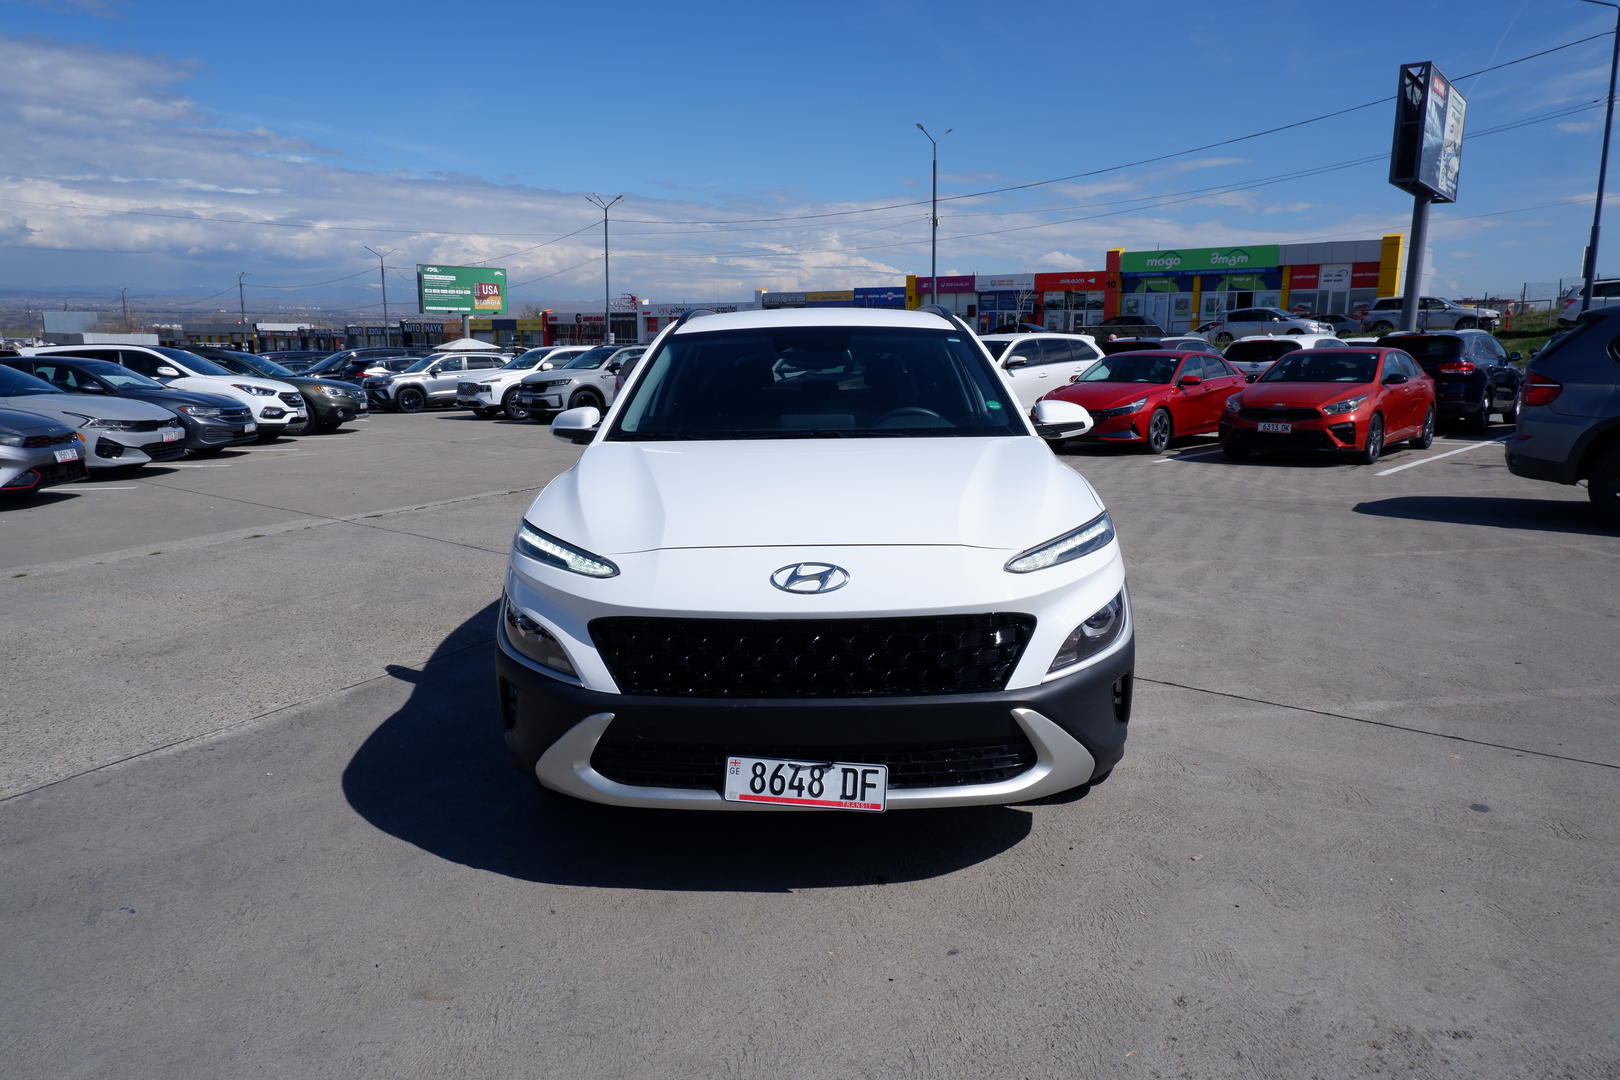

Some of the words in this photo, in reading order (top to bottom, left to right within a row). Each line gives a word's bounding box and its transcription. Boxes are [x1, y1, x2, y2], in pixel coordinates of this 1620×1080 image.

[1146, 257, 1181, 269] mogo
[1105, 280, 1116, 288] 10
[482, 284, 498, 295] USA
[403, 323, 420, 332] AUTO
[425, 323, 443, 333] HAYK
[729, 767, 740, 775] GE
[749, 761, 825, 798] 8648
[839, 767, 880, 802] DF
[841, 801, 872, 809] TRANSIT
